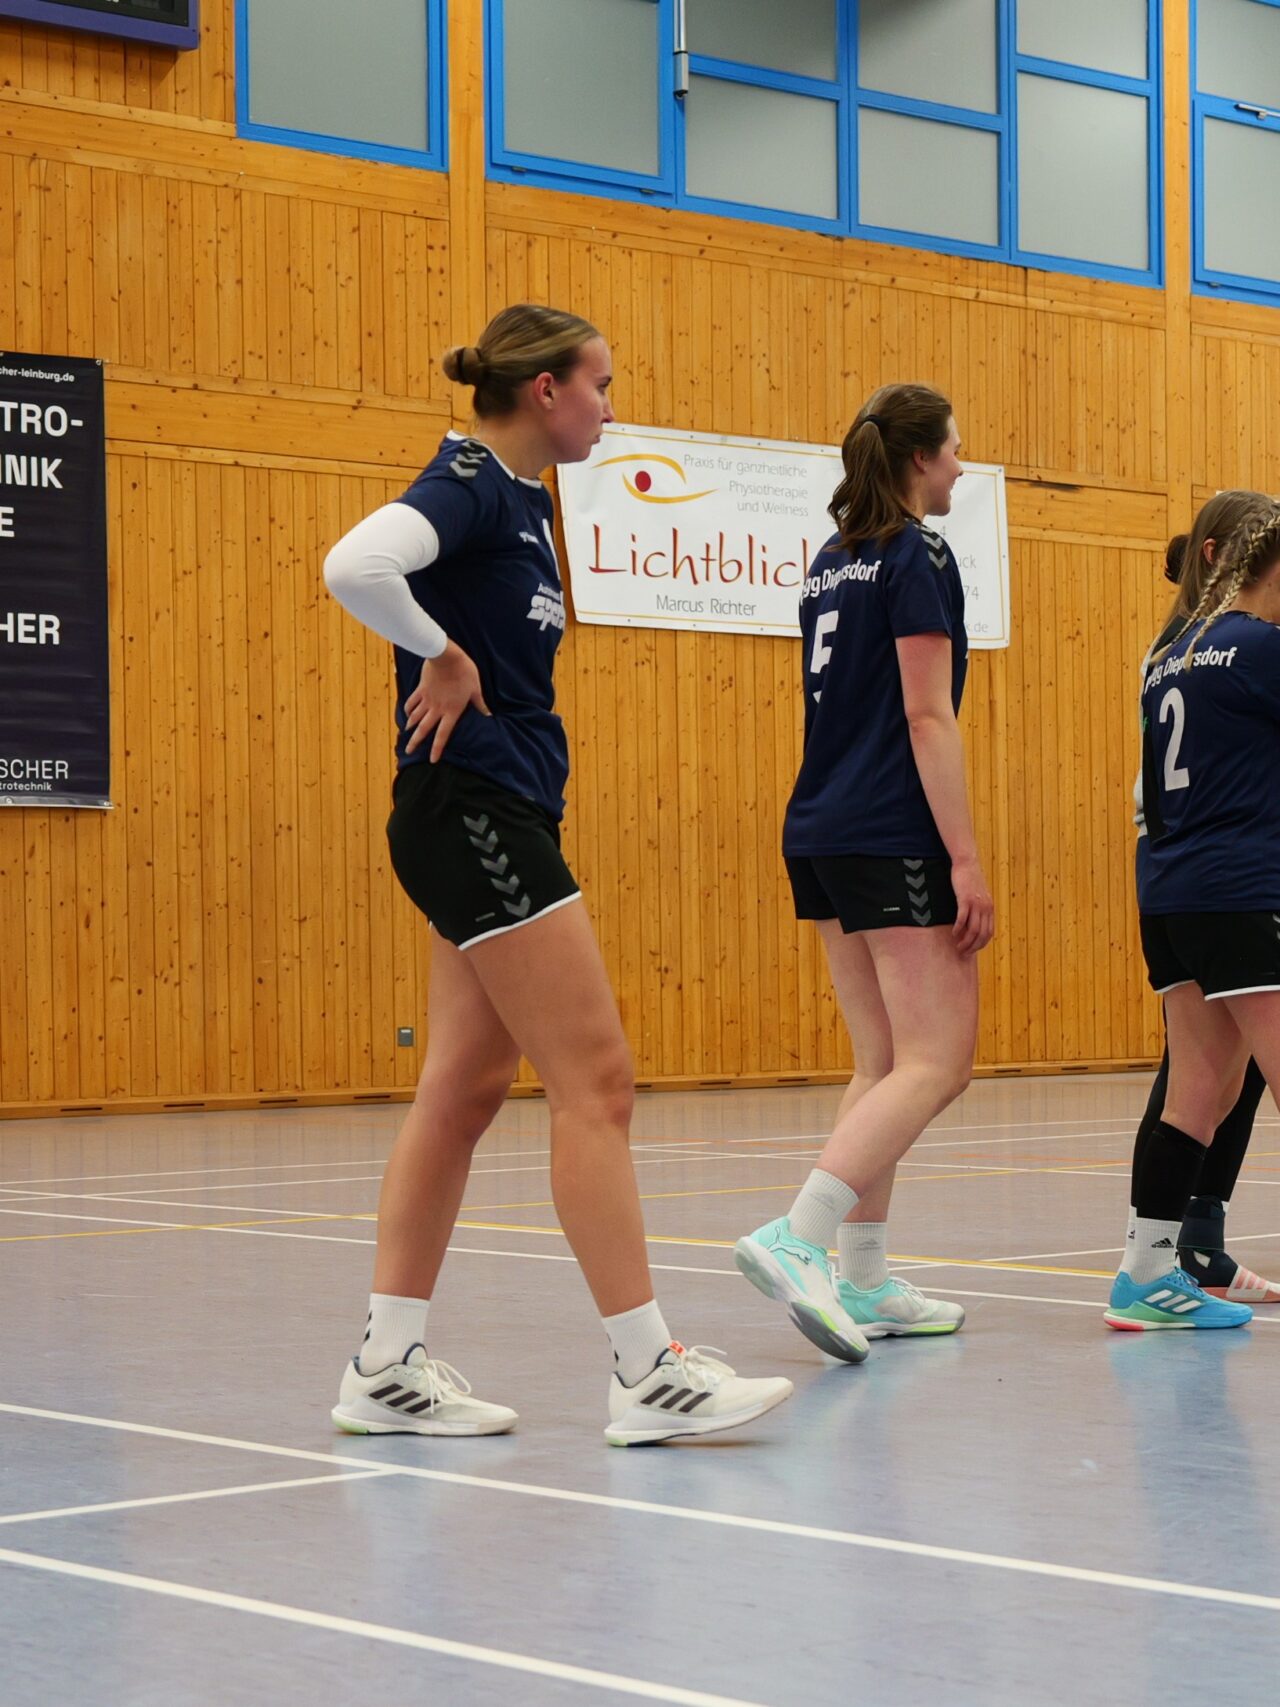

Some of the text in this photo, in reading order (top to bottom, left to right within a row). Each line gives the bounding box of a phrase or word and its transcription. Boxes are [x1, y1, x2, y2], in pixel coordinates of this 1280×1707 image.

[0, 454, 63, 489] NIK
[684, 454, 807, 477] Praxis für ganzheitliche
[729, 480, 808, 500] Physiotherapie
[737, 501, 808, 517] und Wellness
[656, 593, 756, 616] Marcus Richter
[1159, 687, 1190, 791] 2
